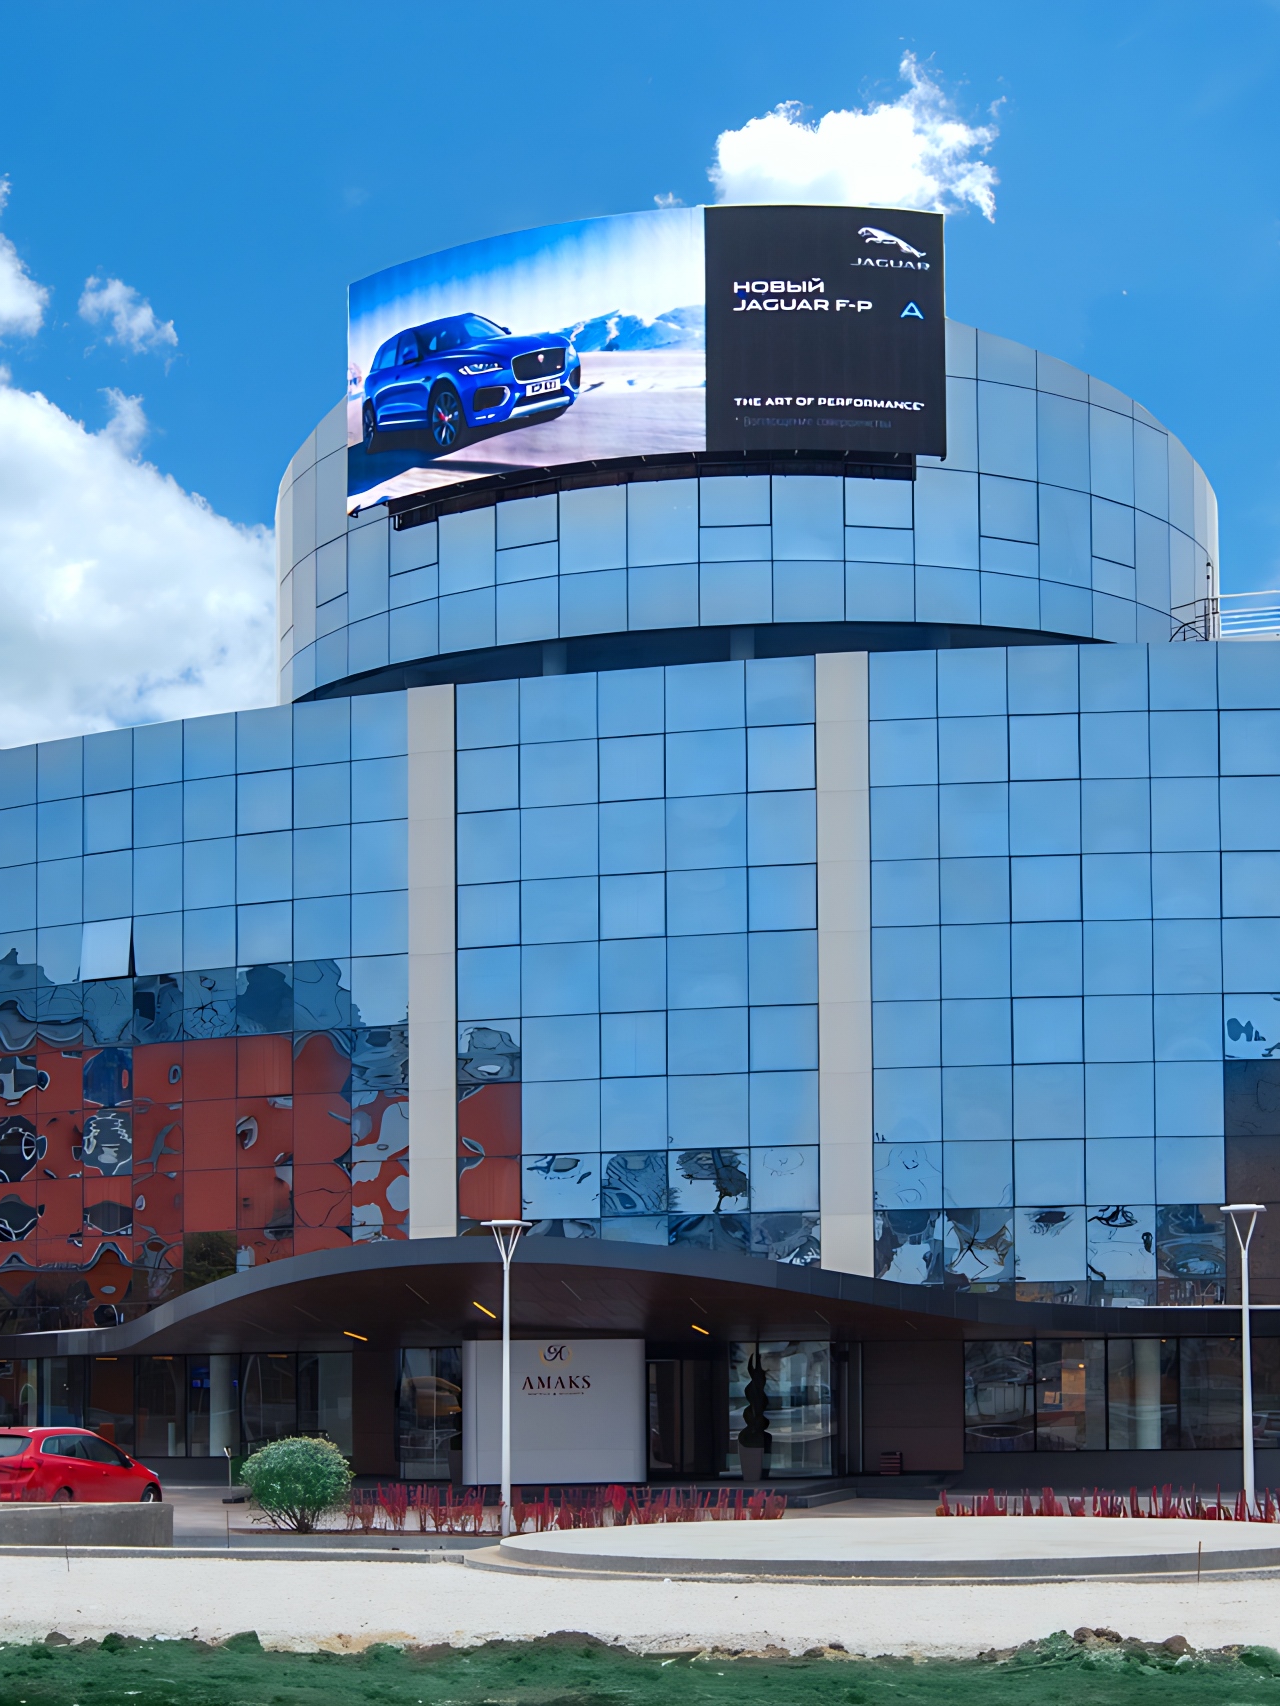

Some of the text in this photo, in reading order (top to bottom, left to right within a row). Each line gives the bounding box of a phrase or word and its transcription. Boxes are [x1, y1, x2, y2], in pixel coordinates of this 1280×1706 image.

[850, 257, 930, 271] JAGUAR
[733, 277, 825, 293] НОВЫЙ
[733, 298, 873, 312] JAGUAR F-P
[734, 397, 762, 406] THE
[765, 397, 793, 406] ART
[795, 397, 815, 406] OF
[522, 1375, 591, 1390] AMAKS
